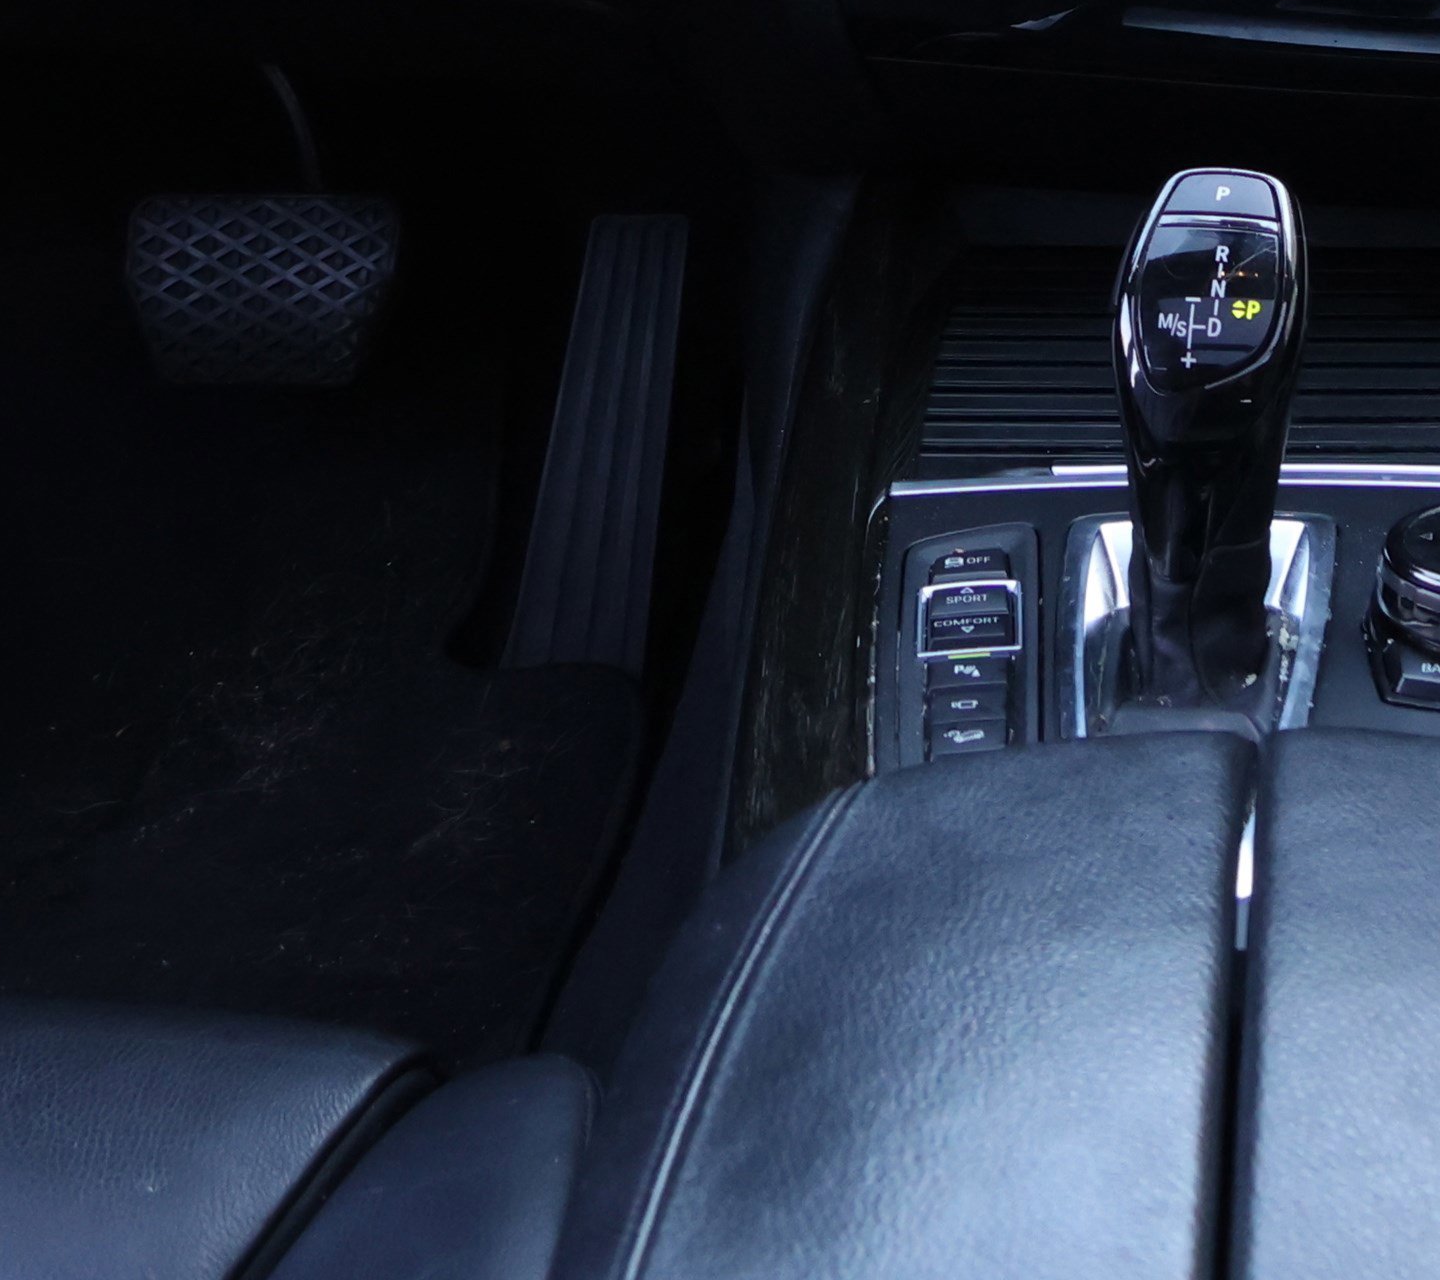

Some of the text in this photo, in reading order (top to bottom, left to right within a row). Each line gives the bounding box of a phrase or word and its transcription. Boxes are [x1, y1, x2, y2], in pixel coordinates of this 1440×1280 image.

[1215, 185, 1231, 201] P
[1215, 245, 1230, 263] R
[1210, 279, 1227, 298] N
[1245, 299, 1261, 320] P
[1158, 312, 1187, 337] M/S
[1207, 317, 1222, 337] D
[966, 556, 991, 565] OFF
[946, 593, 988, 605] SPORT
[933, 615, 1000, 628] COMFORT
